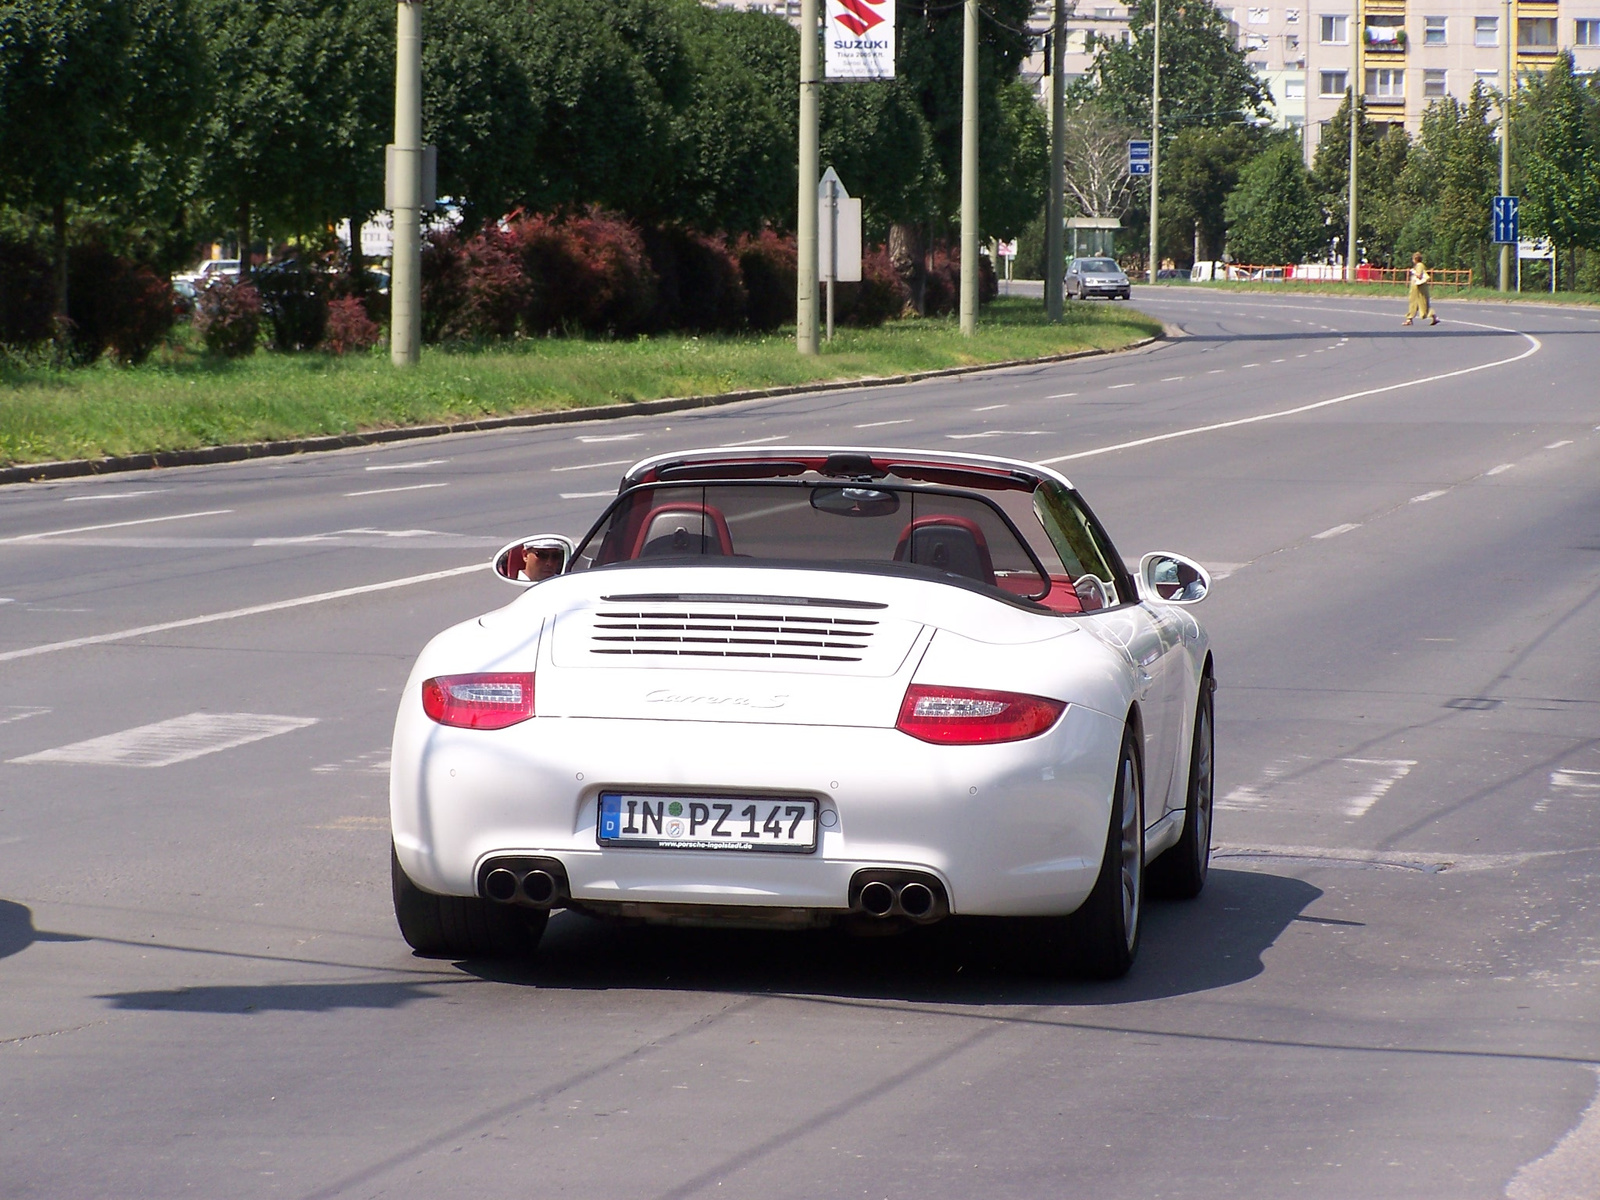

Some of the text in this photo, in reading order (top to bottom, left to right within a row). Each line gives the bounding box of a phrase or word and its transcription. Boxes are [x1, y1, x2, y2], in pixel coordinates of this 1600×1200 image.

[834, 40, 888, 49] SUZUKI
[645, 689, 790, 708] Carrera S
[622, 800, 806, 839] IN PZ 147
